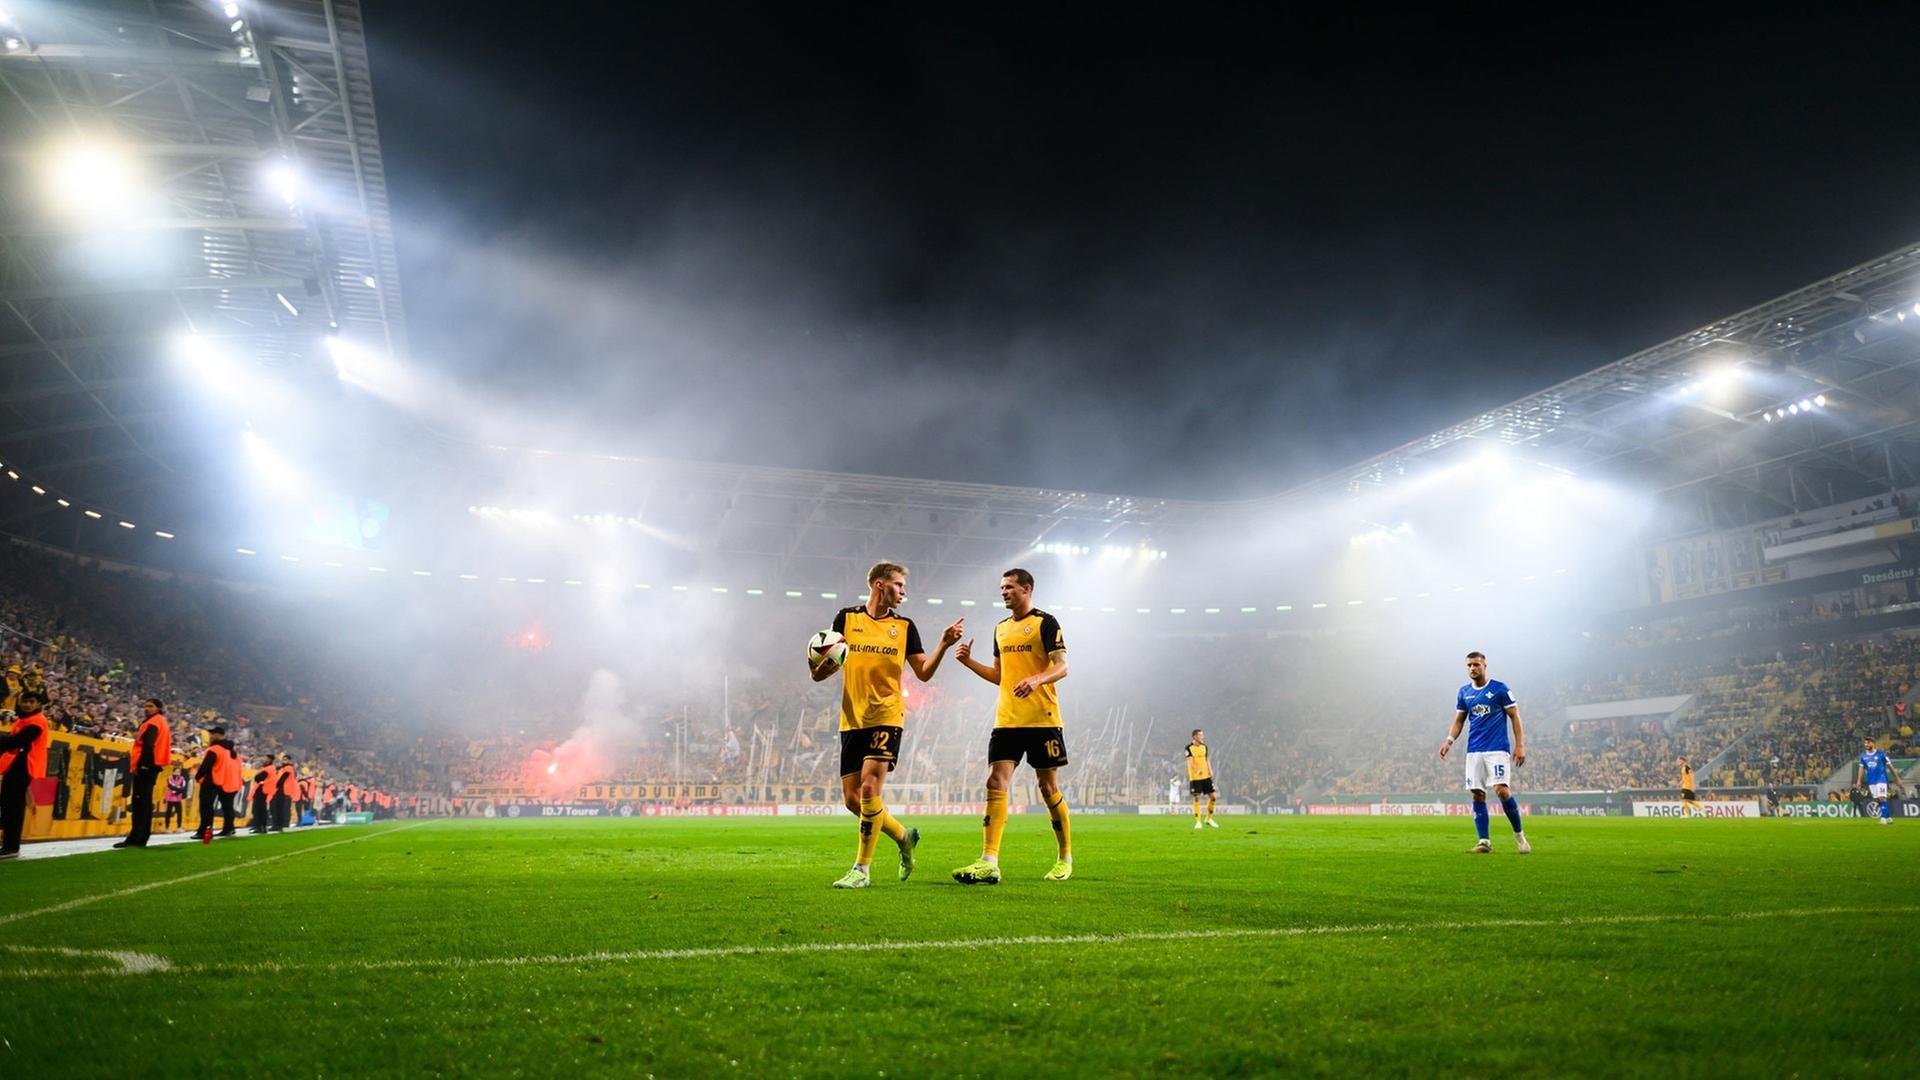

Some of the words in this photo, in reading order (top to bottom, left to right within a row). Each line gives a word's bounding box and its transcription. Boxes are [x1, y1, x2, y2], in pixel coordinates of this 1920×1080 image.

[870, 731, 889, 750] 32
[1045, 739, 1060, 758] 16
[1494, 764, 1505, 776] 15
[542, 807, 562, 816] ID.7
[566, 807, 599, 816] Tourer
[727, 805, 774, 816] STRAUSS
[797, 805, 833, 815] ERGO
